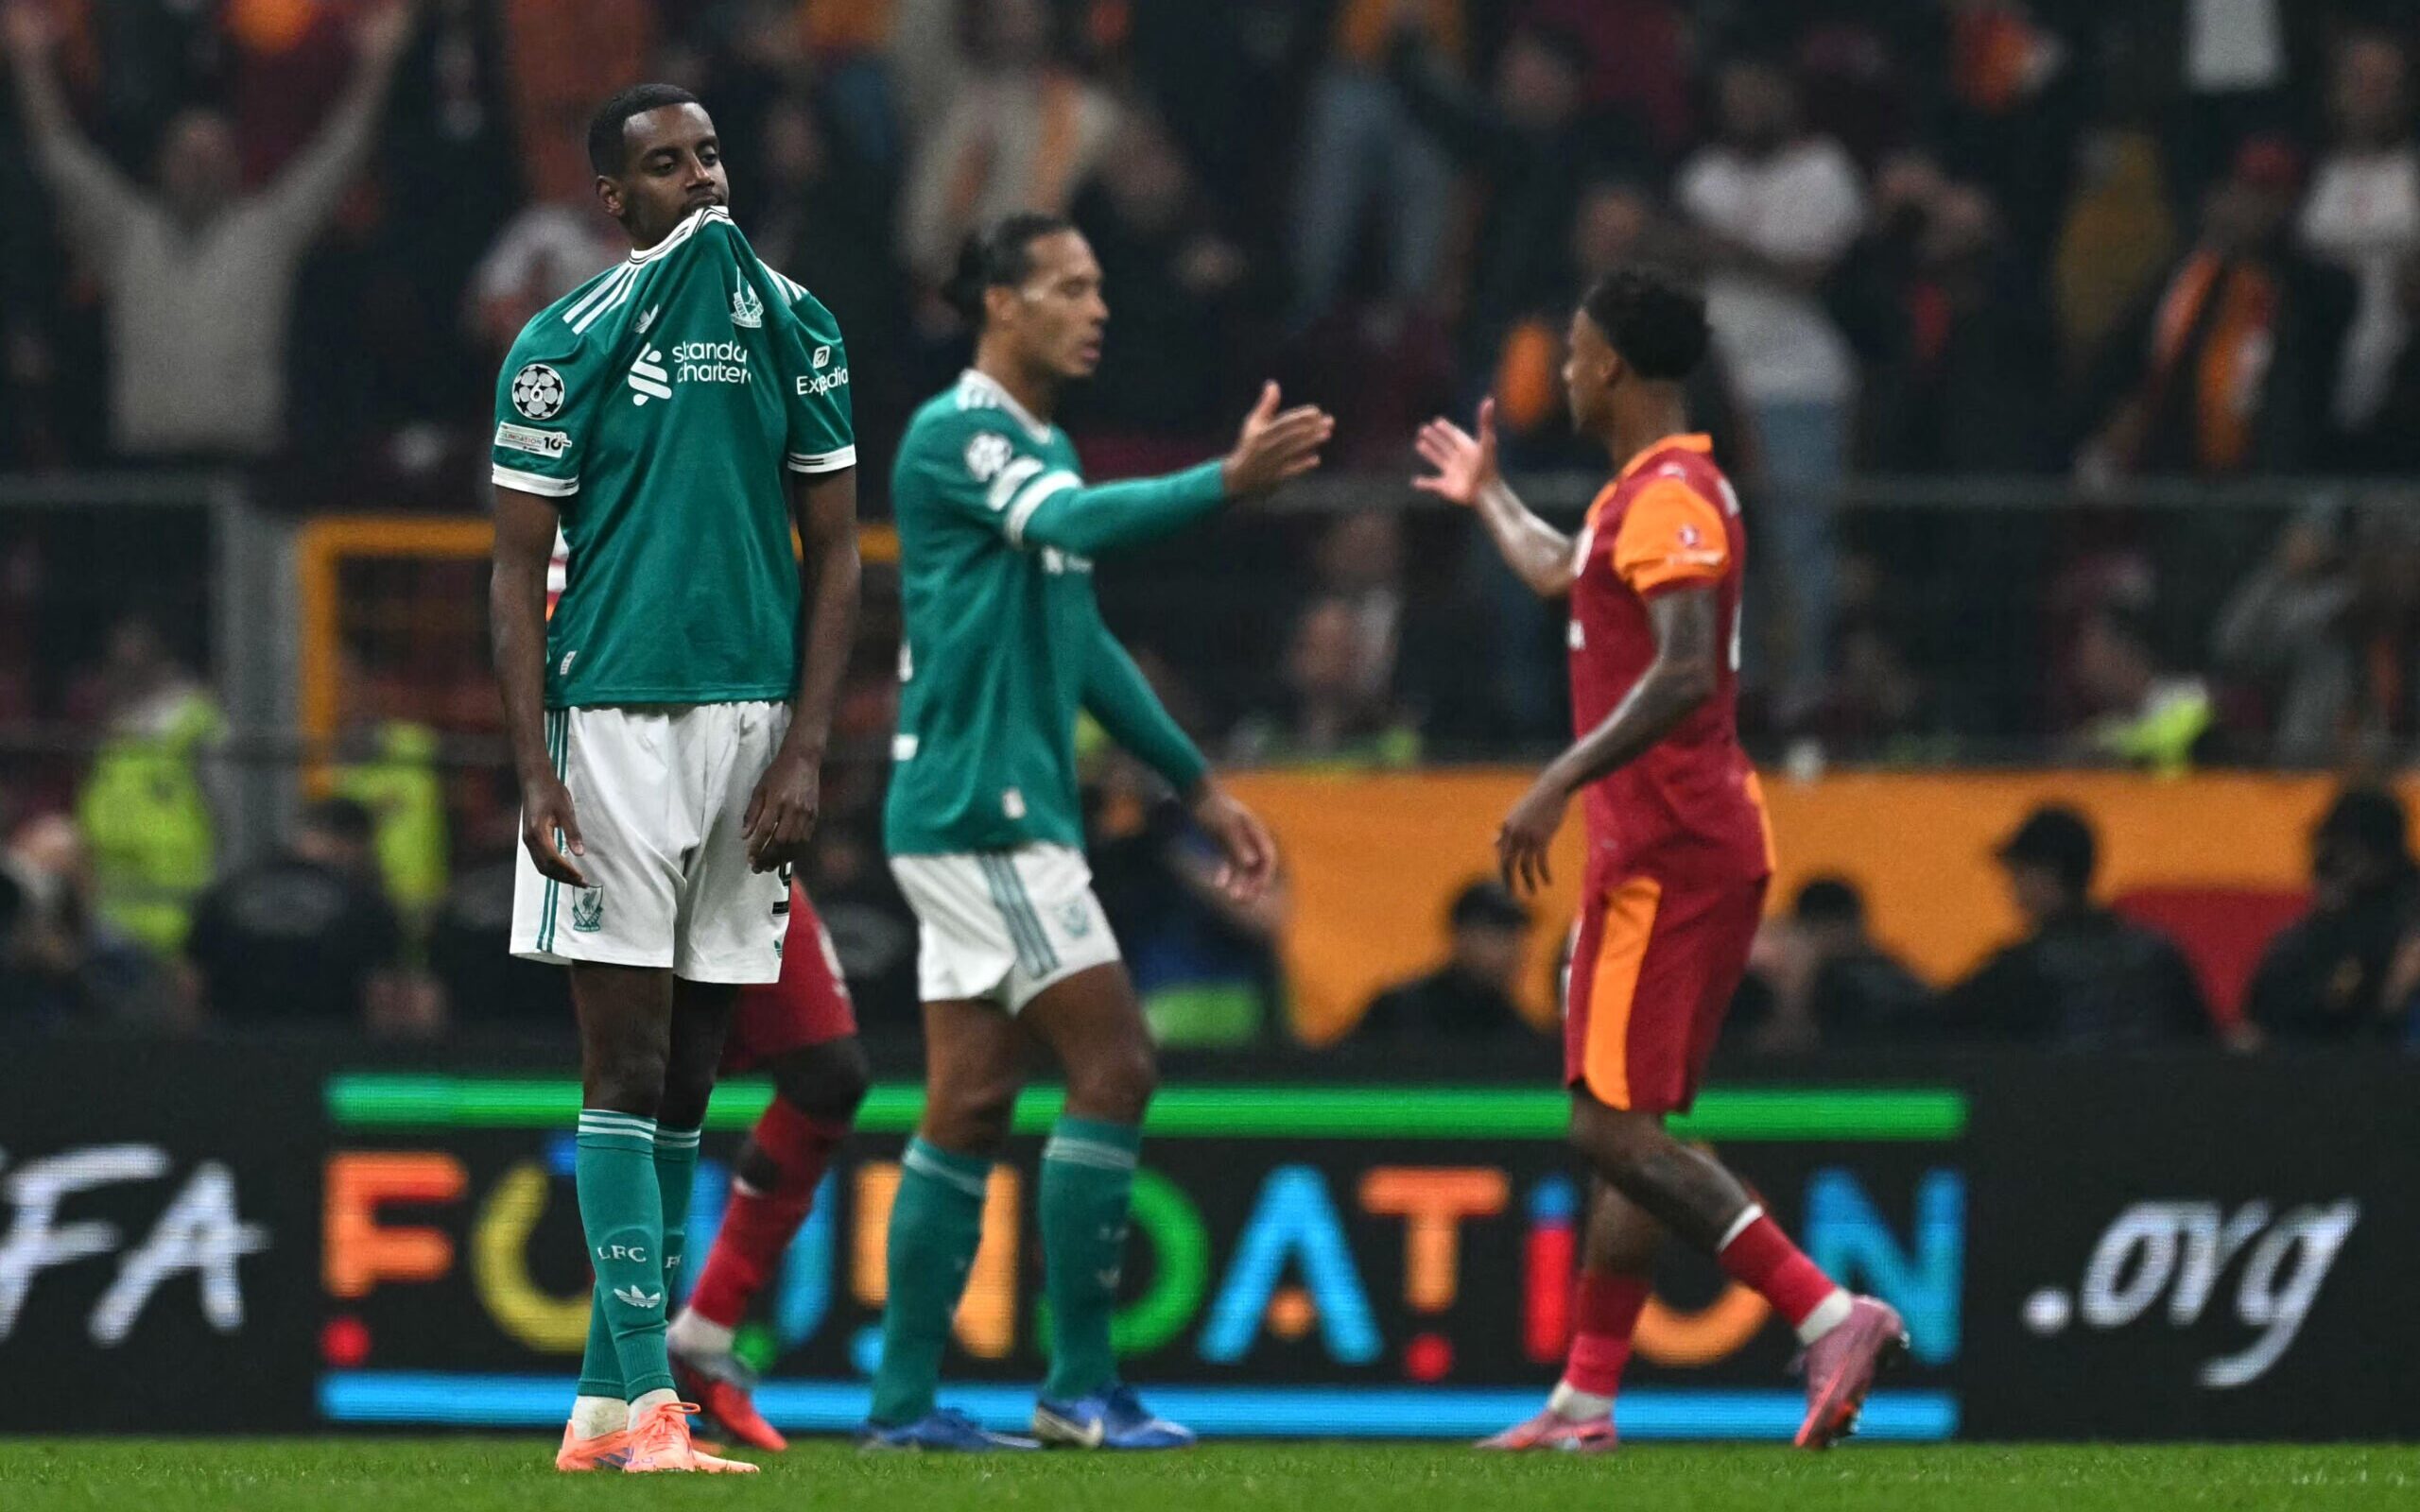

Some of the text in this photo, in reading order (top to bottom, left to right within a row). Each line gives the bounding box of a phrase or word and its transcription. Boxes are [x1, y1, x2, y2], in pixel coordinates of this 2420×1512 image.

[677, 361, 752, 384] charter
[529, 381, 544, 402] 6
[596, 1245, 648, 1263] LFC
[0, 1143, 273, 1348] FA
[2021, 1196, 2361, 1389] .org
